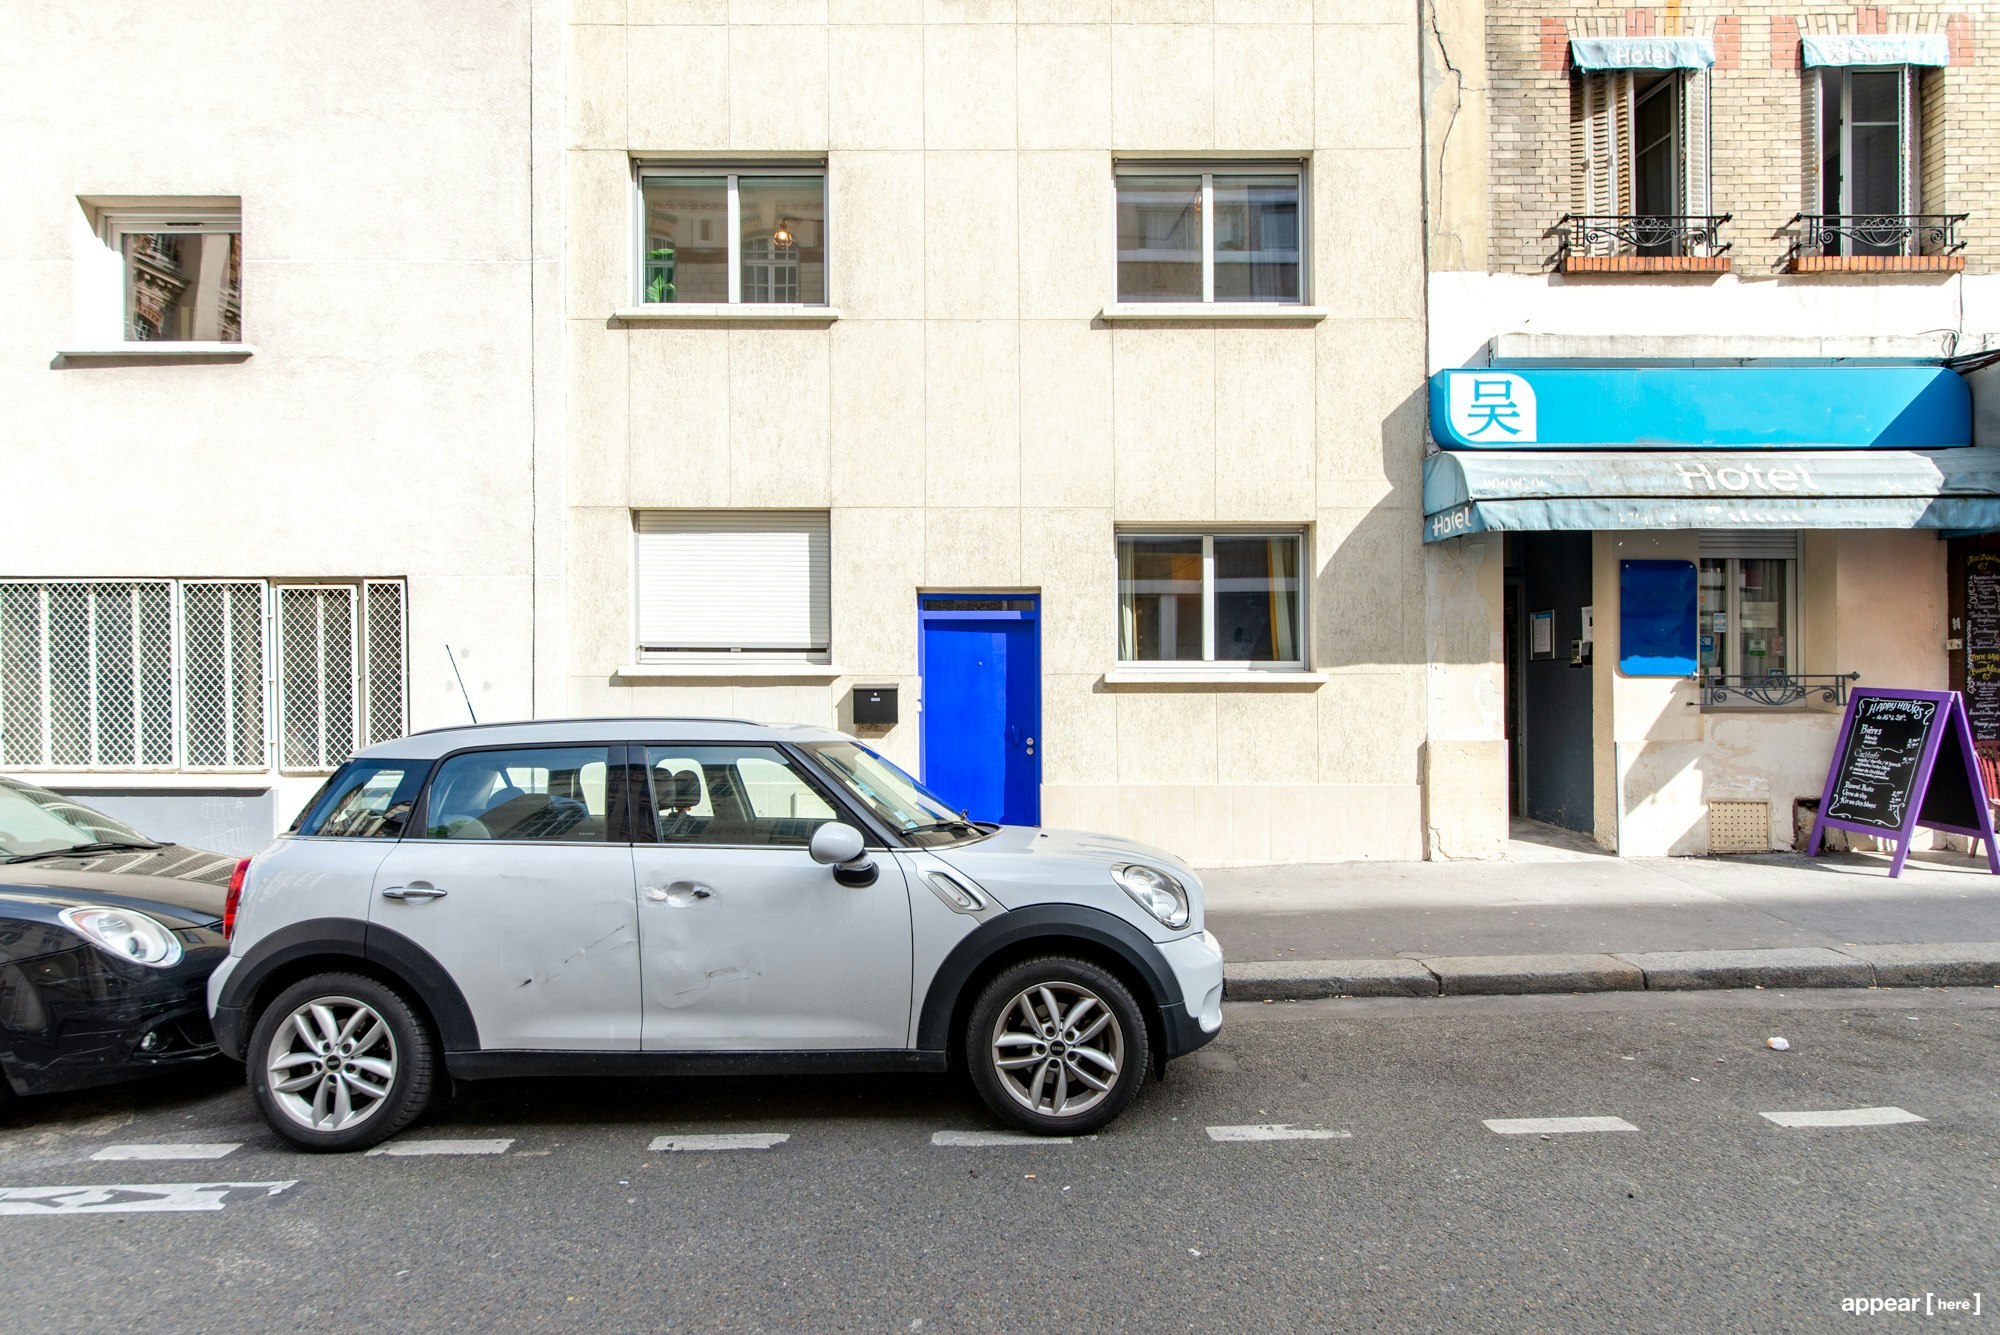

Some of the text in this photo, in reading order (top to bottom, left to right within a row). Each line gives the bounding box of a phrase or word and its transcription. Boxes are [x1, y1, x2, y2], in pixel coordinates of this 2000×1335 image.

[1615, 47, 1670, 65] Hotel
[1467, 379, 1523, 436] 吴
[1674, 462, 1819, 492] Hotel
[1432, 506, 1472, 537] Hotel
[1866, 701, 1924, 720] HAPPY HOURS
[1859, 723, 1882, 735] Bières
